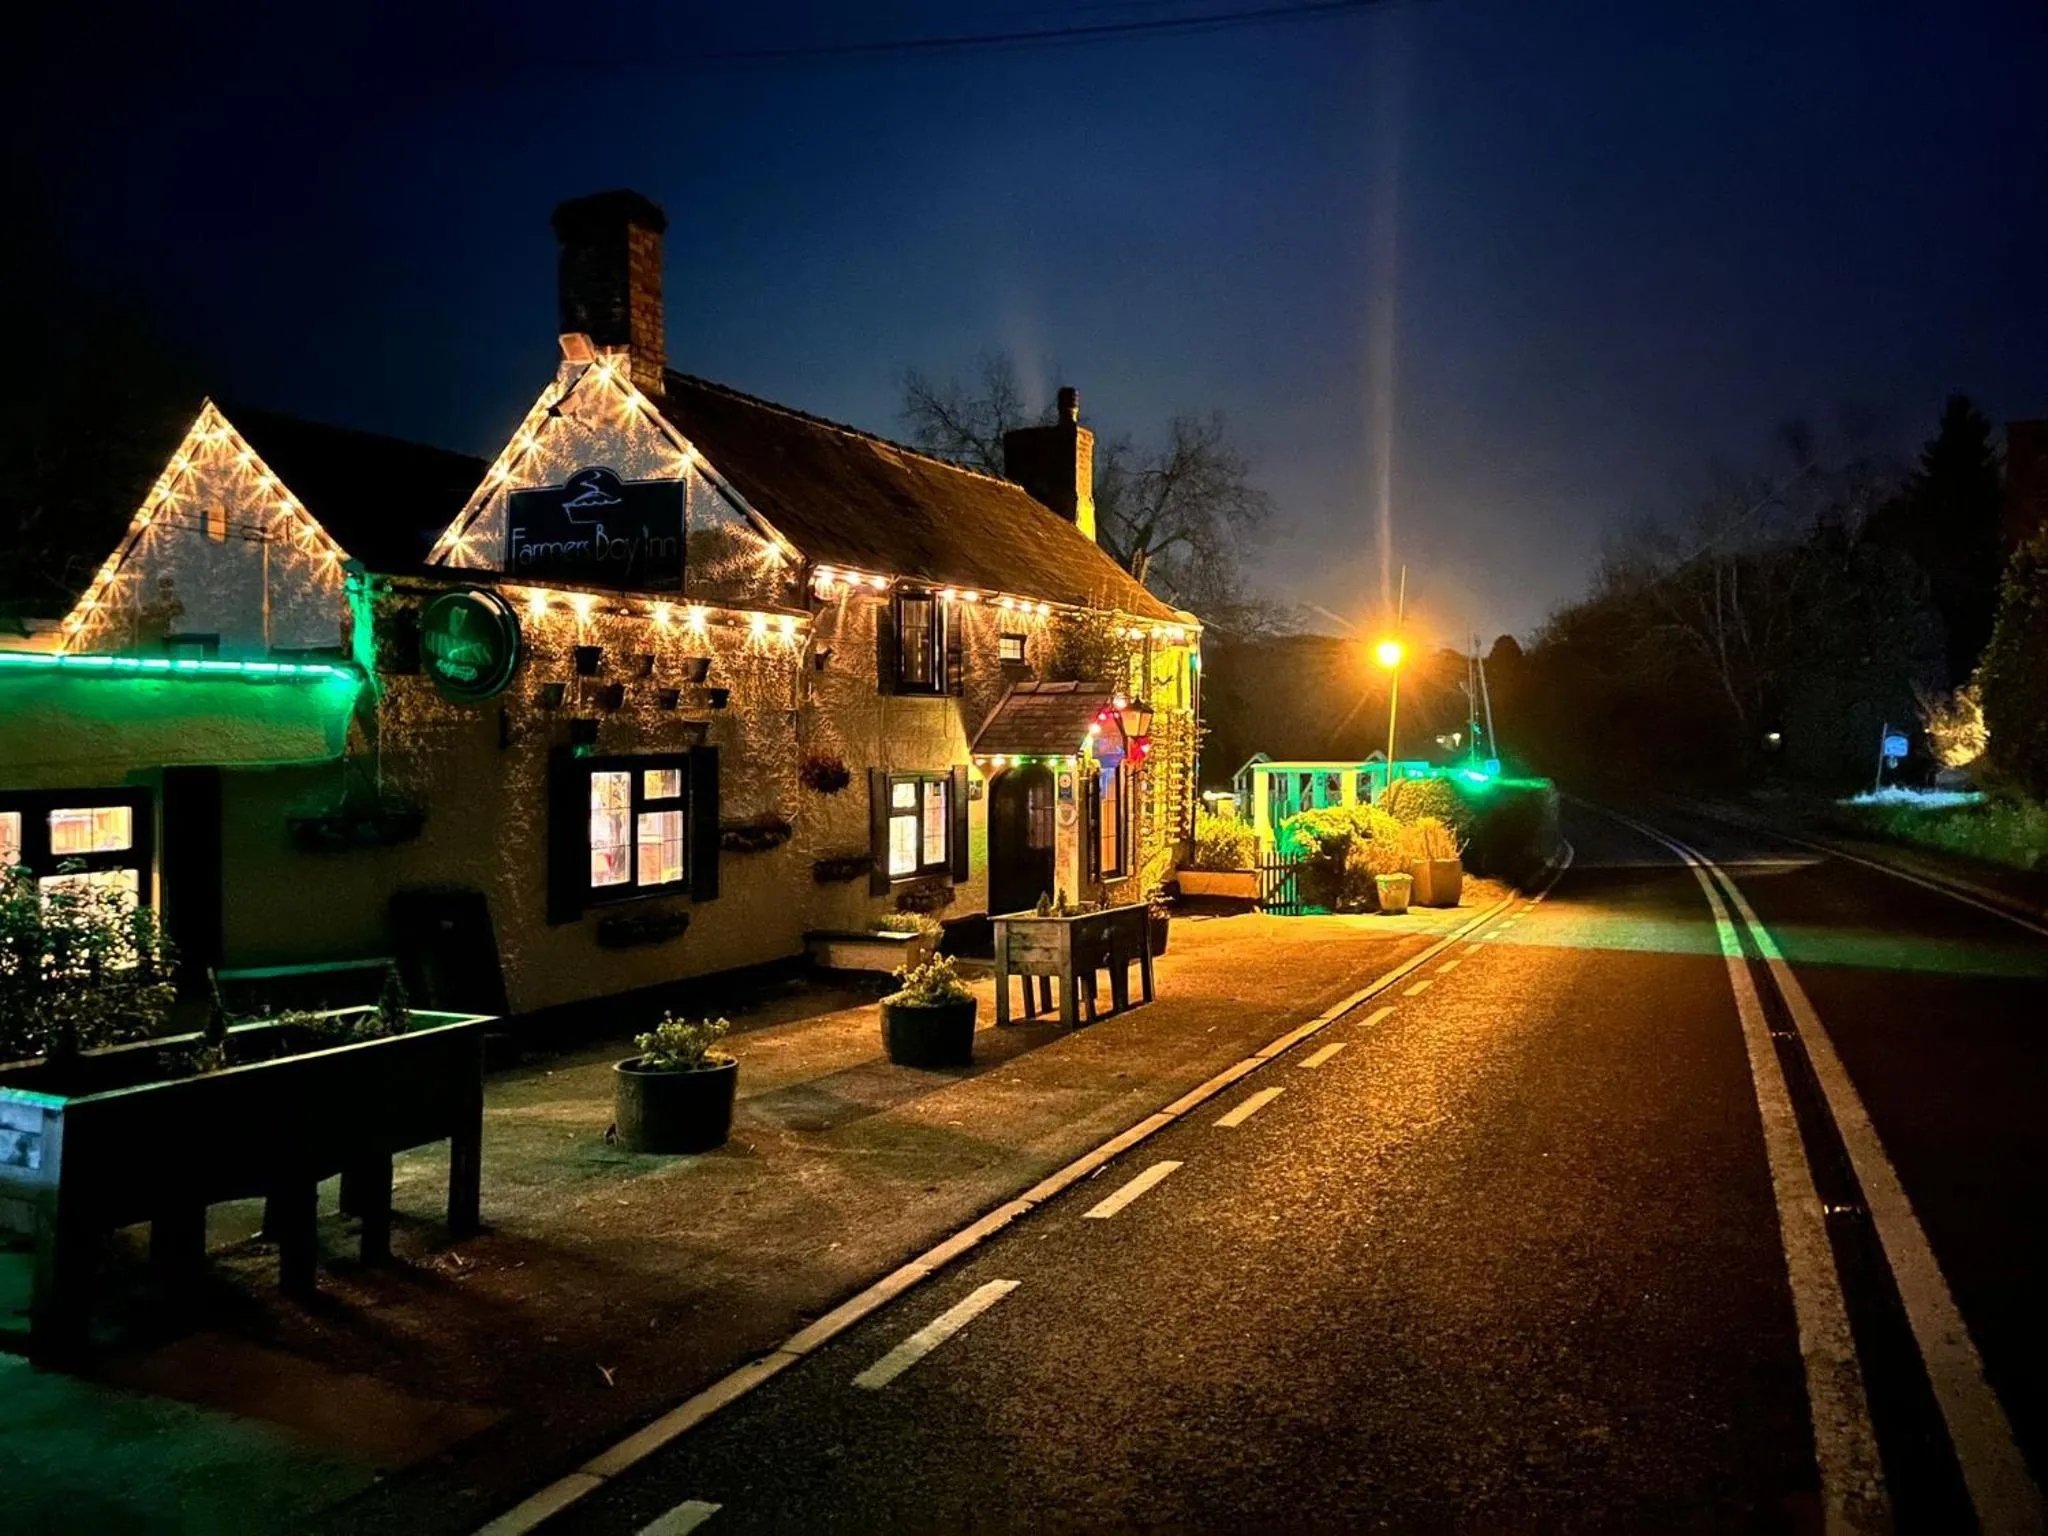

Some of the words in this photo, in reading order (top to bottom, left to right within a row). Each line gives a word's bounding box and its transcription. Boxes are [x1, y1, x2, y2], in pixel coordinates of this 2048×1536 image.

[512, 527, 592, 573] Farmers
[596, 523, 640, 577] Boy
[642, 523, 677, 571] Inn
